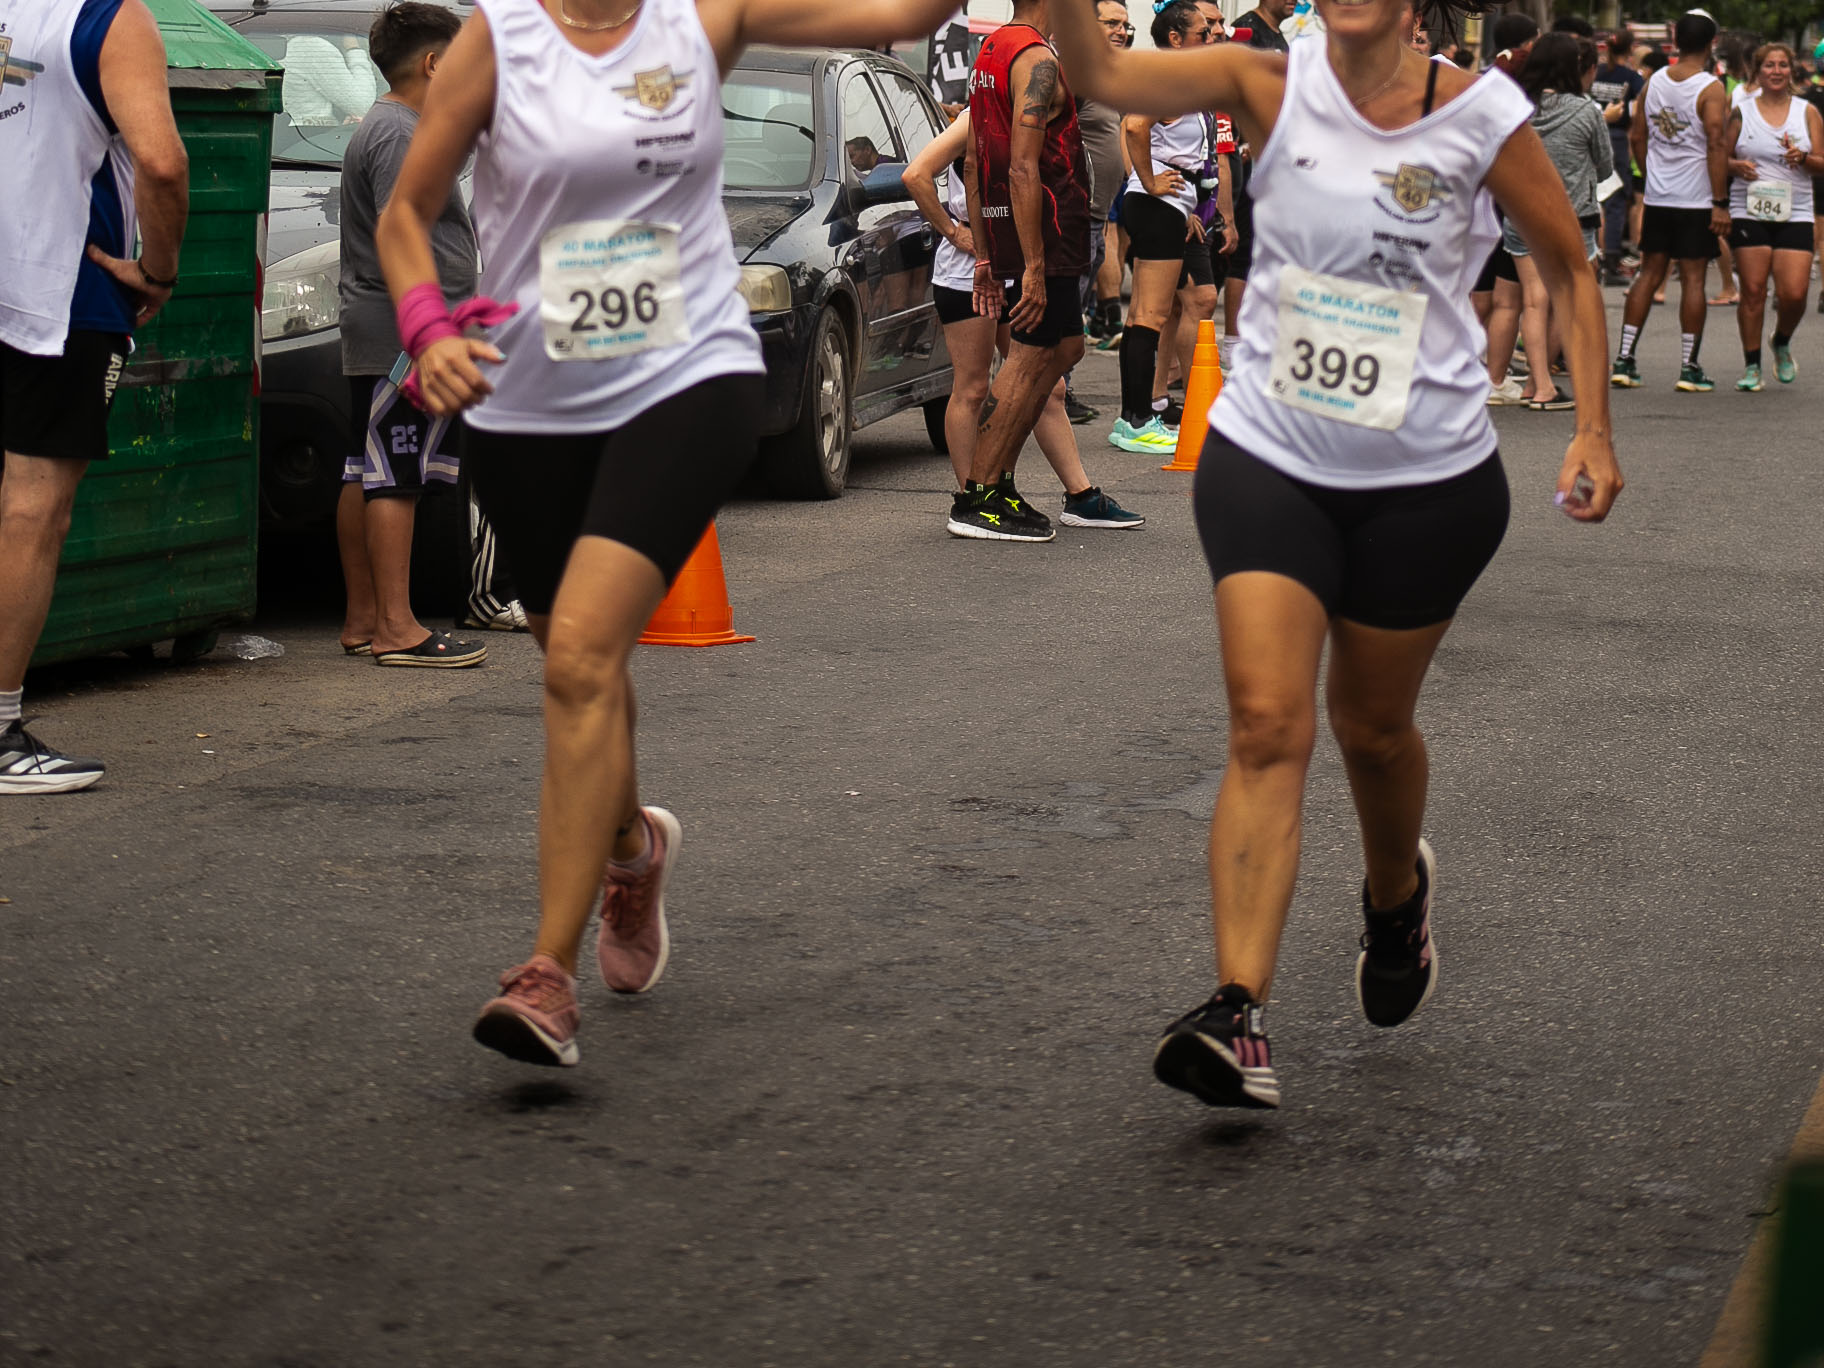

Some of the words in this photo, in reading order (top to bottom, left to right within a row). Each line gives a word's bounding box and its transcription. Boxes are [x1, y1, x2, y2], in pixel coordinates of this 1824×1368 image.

[1753, 199, 1782, 215] 484
[569, 282, 660, 333] 296
[1319, 293, 1400, 320] MARATON
[1290, 337, 1381, 397] 399
